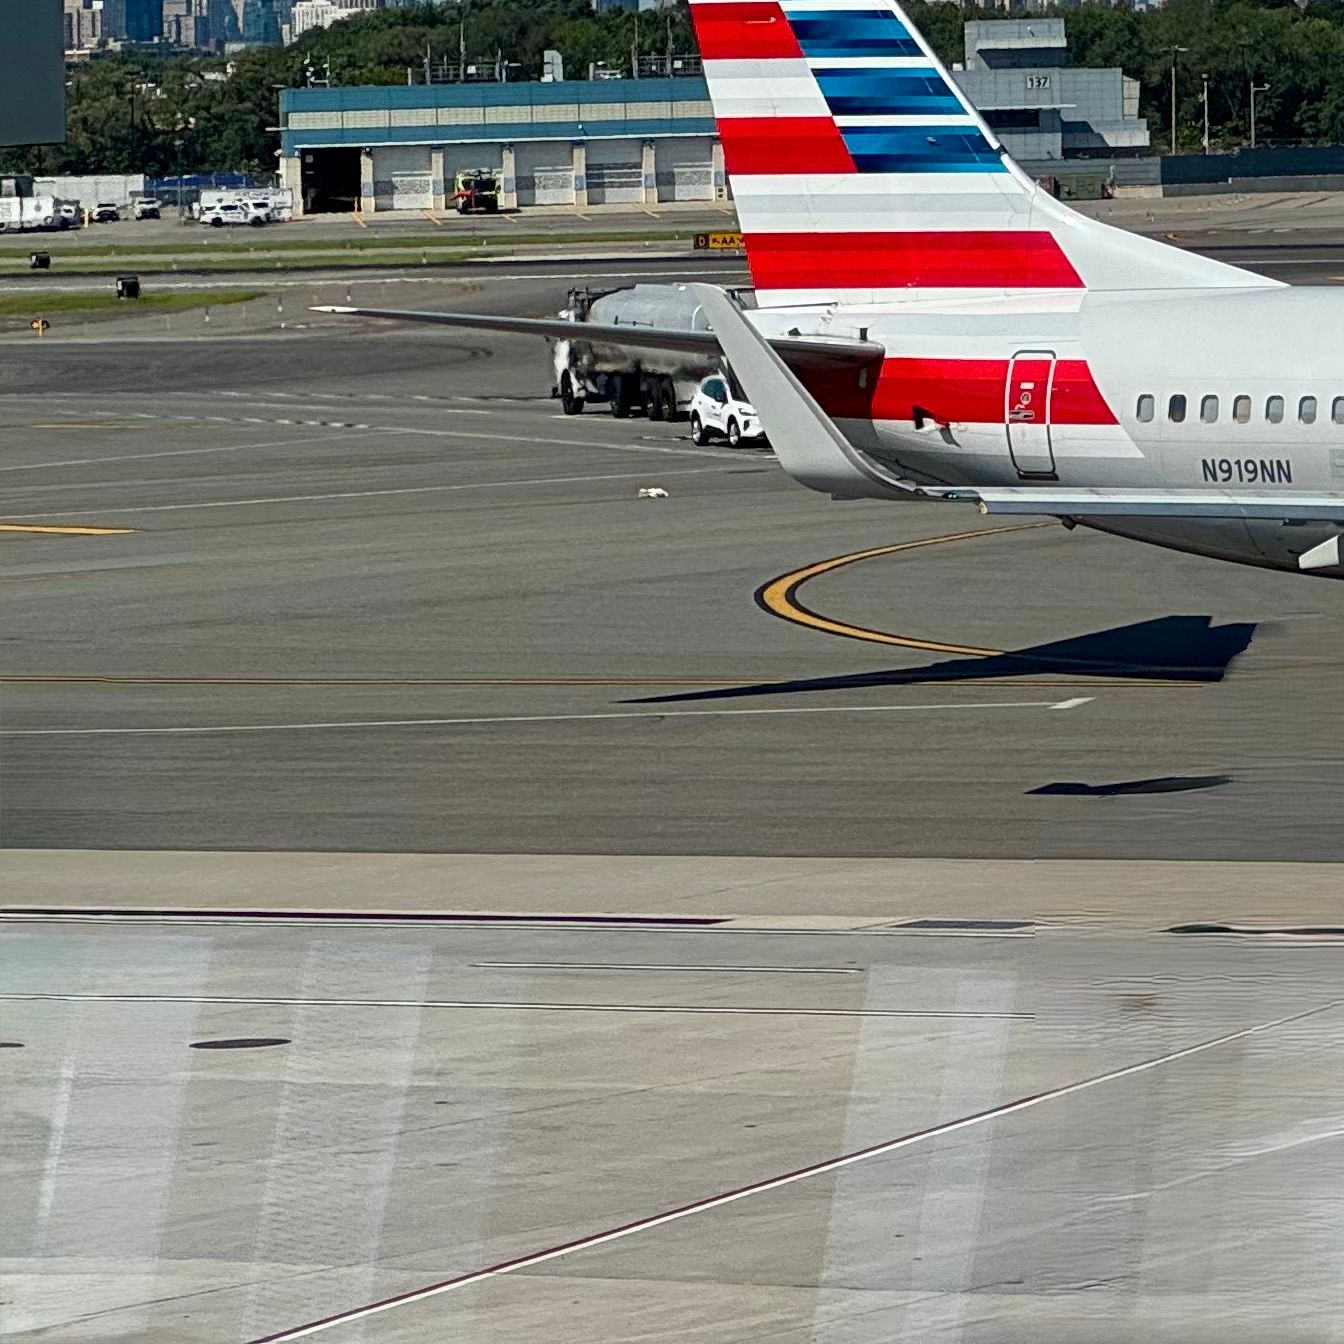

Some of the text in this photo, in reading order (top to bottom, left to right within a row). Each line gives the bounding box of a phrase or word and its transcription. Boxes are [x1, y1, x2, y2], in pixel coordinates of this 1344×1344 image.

[1028, 76, 1048, 87] 137
[721, 236, 736, 245] AA
[1201, 459, 1293, 484] N919NN
